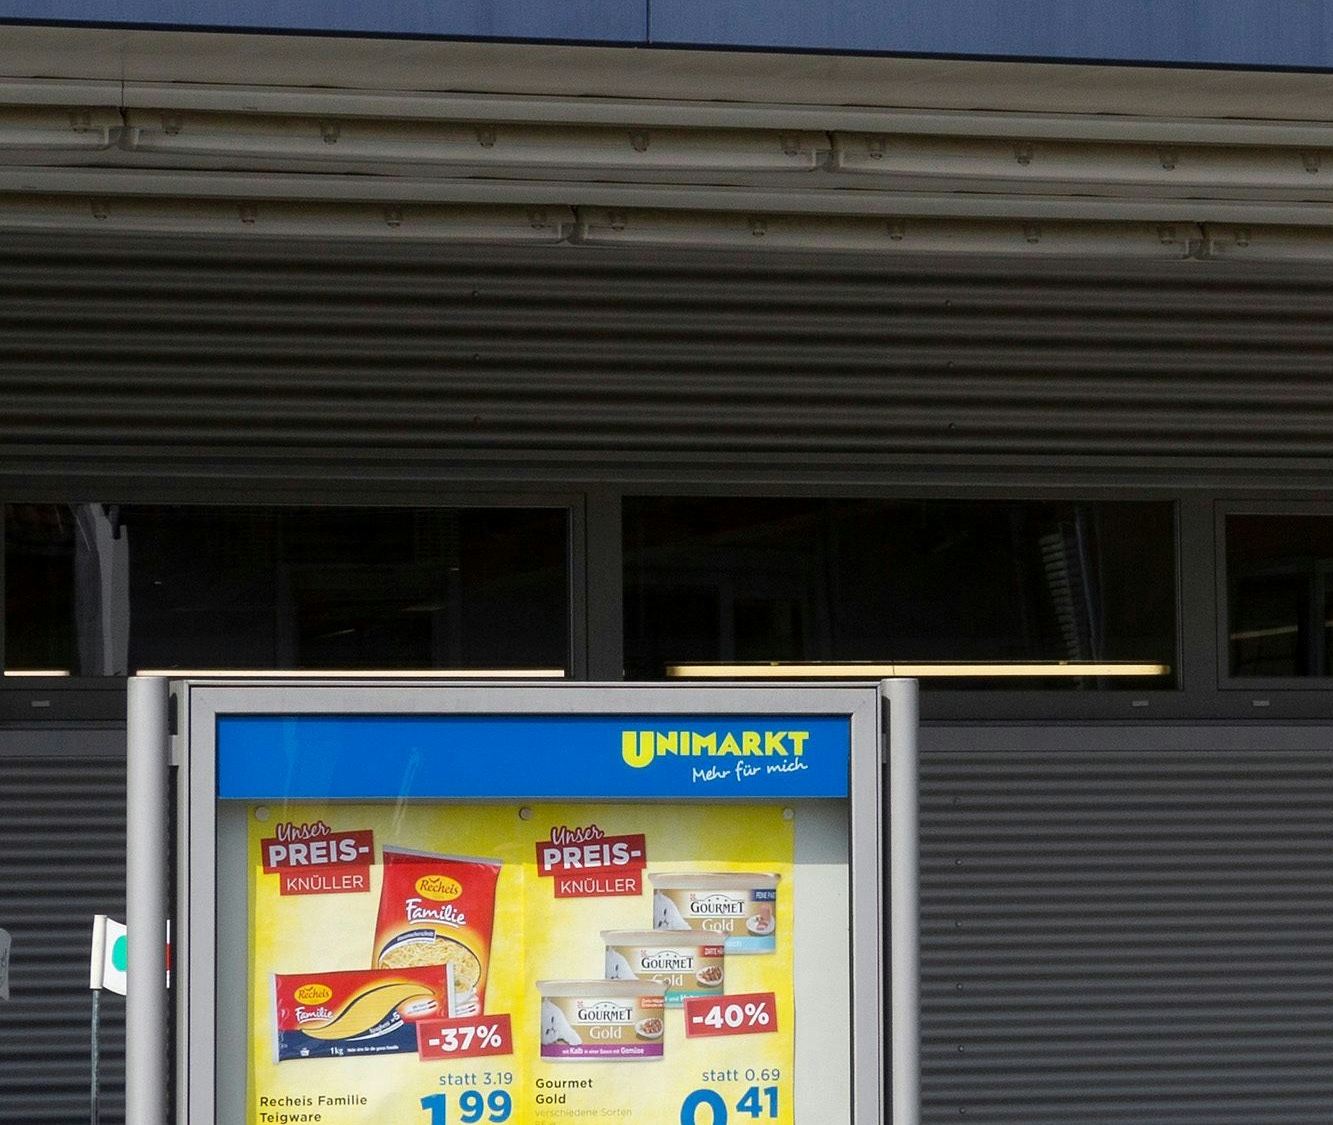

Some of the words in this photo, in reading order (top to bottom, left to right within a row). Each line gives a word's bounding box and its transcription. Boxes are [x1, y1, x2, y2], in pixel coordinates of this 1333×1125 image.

[622, 731, 810, 768] UNIMARKT
[692, 767, 731, 783] Mehr
[735, 760, 760, 781] für
[766, 757, 808, 774] mich
[277, 822, 331, 842] Unser
[551, 826, 604, 846] Unser
[268, 838, 370, 868] PREIS-
[543, 842, 641, 871] PREIS-
[286, 874, 364, 891] KNÜLLER
[419, 878, 459, 895] Recheis
[560, 877, 636, 894] KNÜLLER
[405, 898, 467, 926] Familie
[690, 901, 745, 914] GOURMET
[701, 918, 735, 932] Gold
[641, 957, 694, 969] GOURMET
[297, 987, 330, 1000] Recheis
[295, 1007, 335, 1022] Familie
[577, 1008, 633, 1021] GOURMET
[692, 1002, 770, 1029] -40%
[428, 1024, 502, 1052] -37%
[589, 1026, 622, 1040] Gold
[439, 1073, 477, 1086] statt
[483, 1072, 514, 1086] 3.19
[702, 1070, 739, 1082] statt
[745, 1068, 781, 1082] 0.69
[535, 1078, 593, 1089] Gourmet
[259, 1095, 313, 1107] Recheis
[318, 1094, 368, 1106] Familie
[535, 1094, 567, 1105] Gold
[259, 1112, 322, 1124] Teigware
[601, 1107, 633, 1117] Sorten
